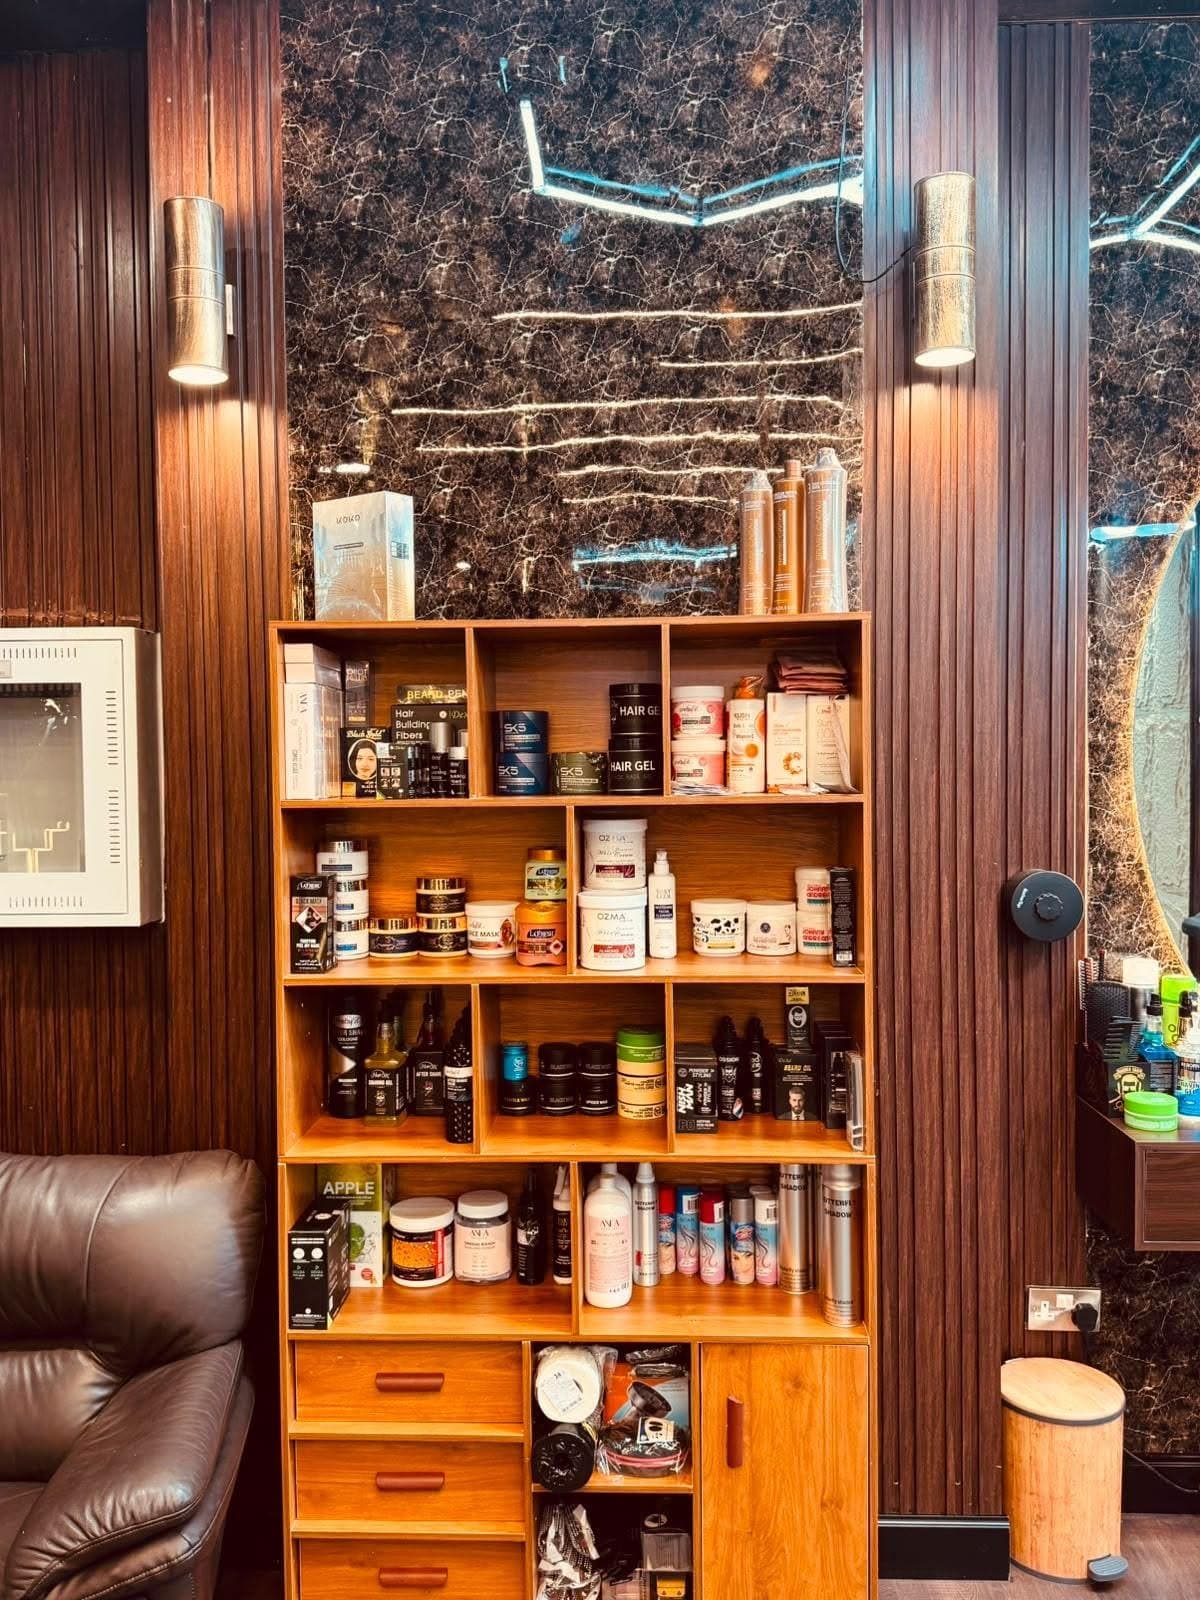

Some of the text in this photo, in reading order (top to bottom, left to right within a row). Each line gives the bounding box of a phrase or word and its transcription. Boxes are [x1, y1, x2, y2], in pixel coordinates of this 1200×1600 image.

[395, 709, 414, 718] Hair
[619, 705, 661, 716] HAIR GE
[395, 720, 430, 730] Building
[395, 730, 423, 739] Fibers
[610, 760, 656, 772] HAIR GEL
[597, 913, 626, 921] OZMA
[322, 1181, 376, 1195] APPLE
